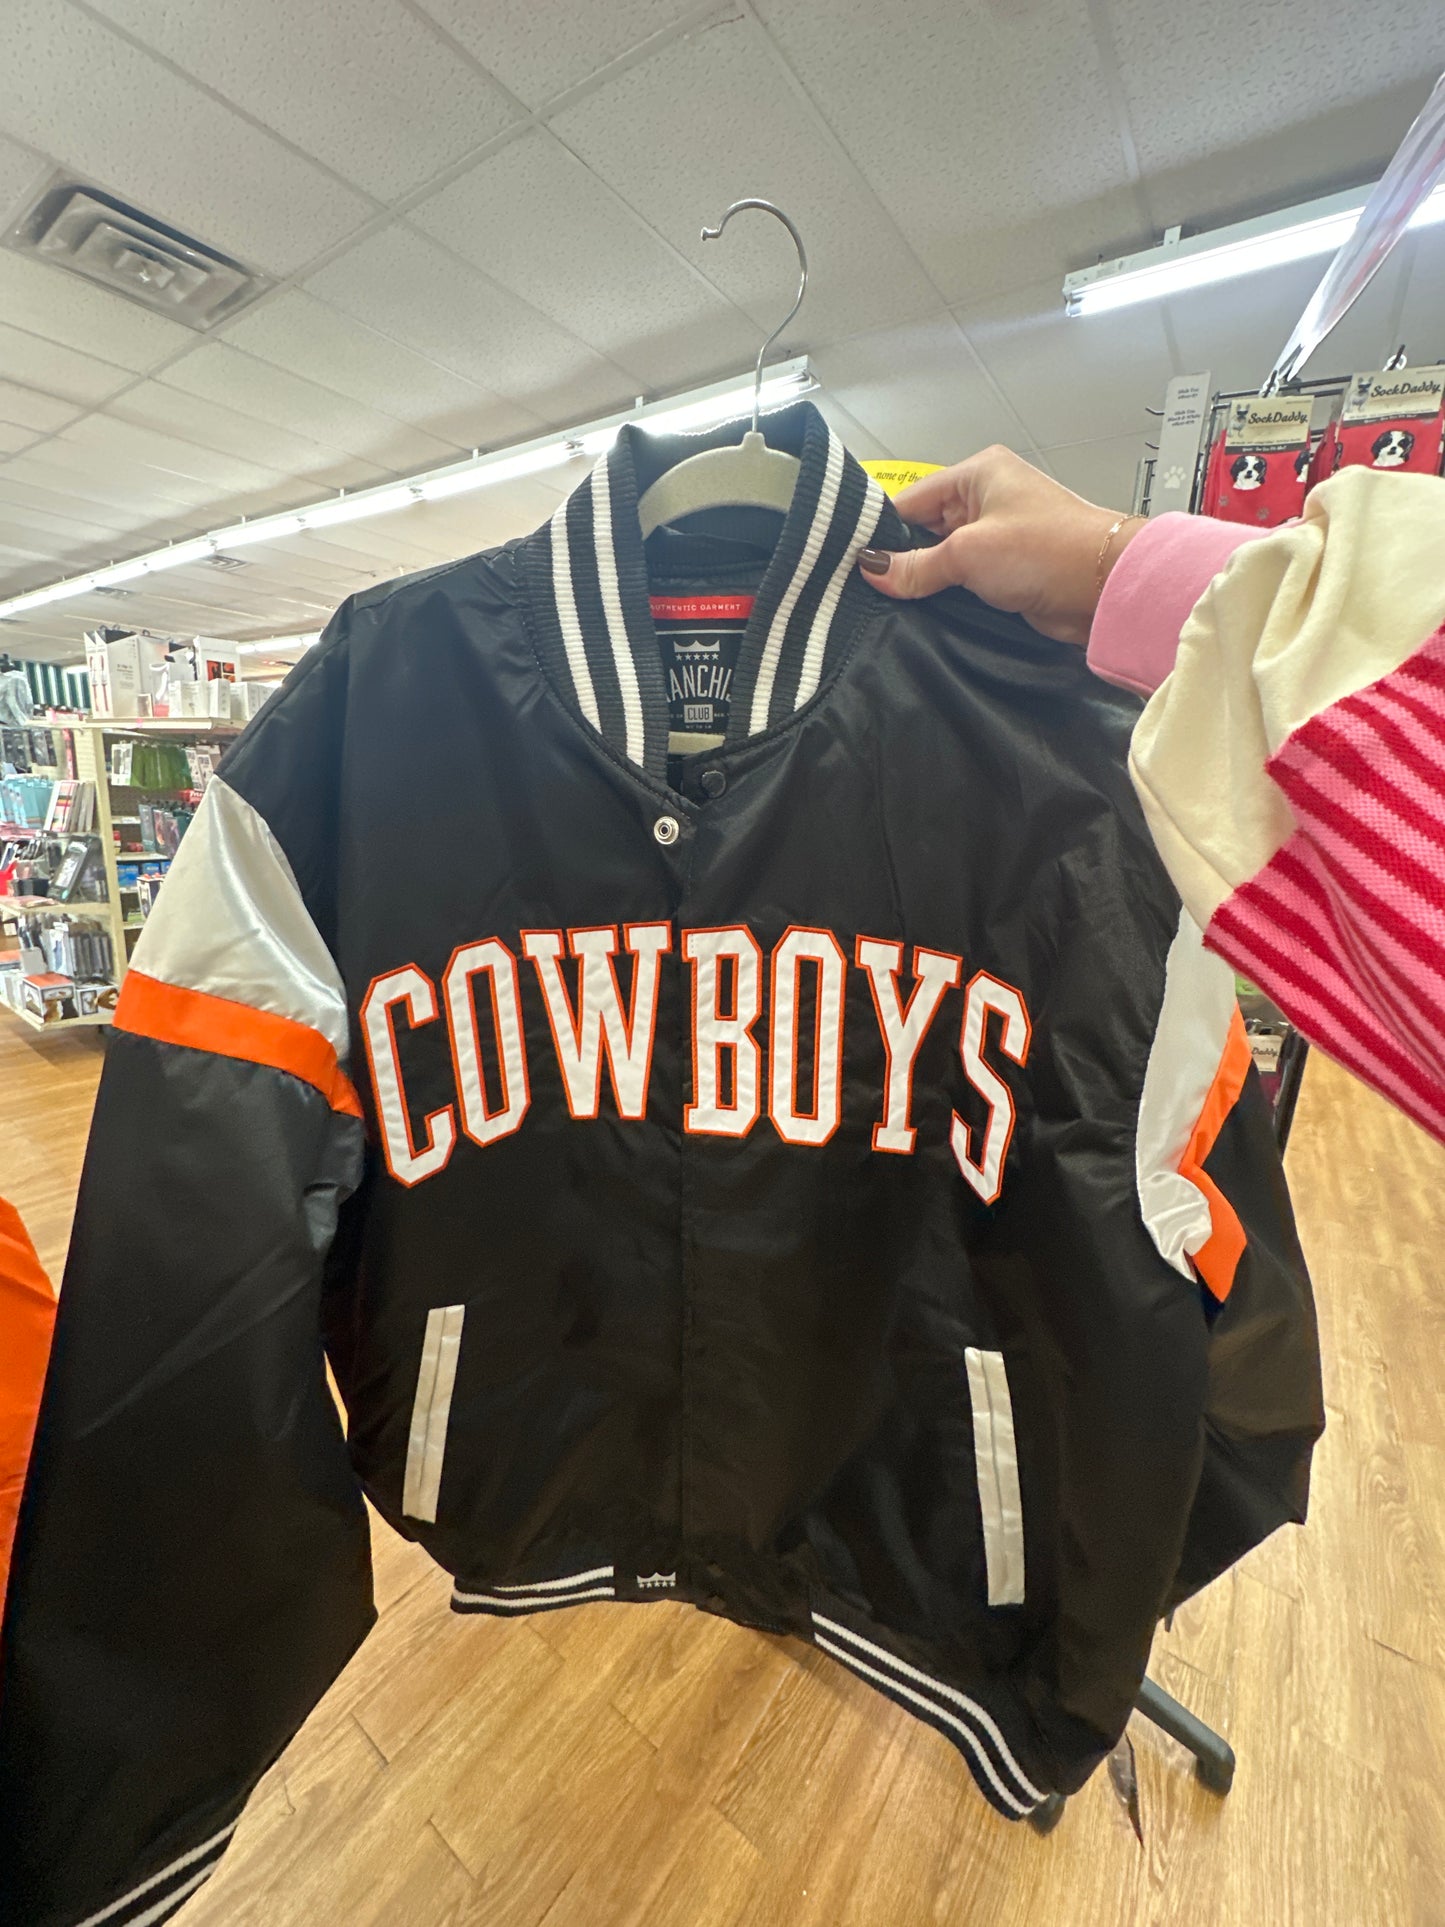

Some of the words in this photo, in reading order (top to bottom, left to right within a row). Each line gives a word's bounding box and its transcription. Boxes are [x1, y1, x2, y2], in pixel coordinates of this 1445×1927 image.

[898, 471, 910, 485] of
[666, 665, 732, 703] ANCHI
[687, 707, 710, 721] CLUB
[359, 920, 1031, 1206] COWBOYS
